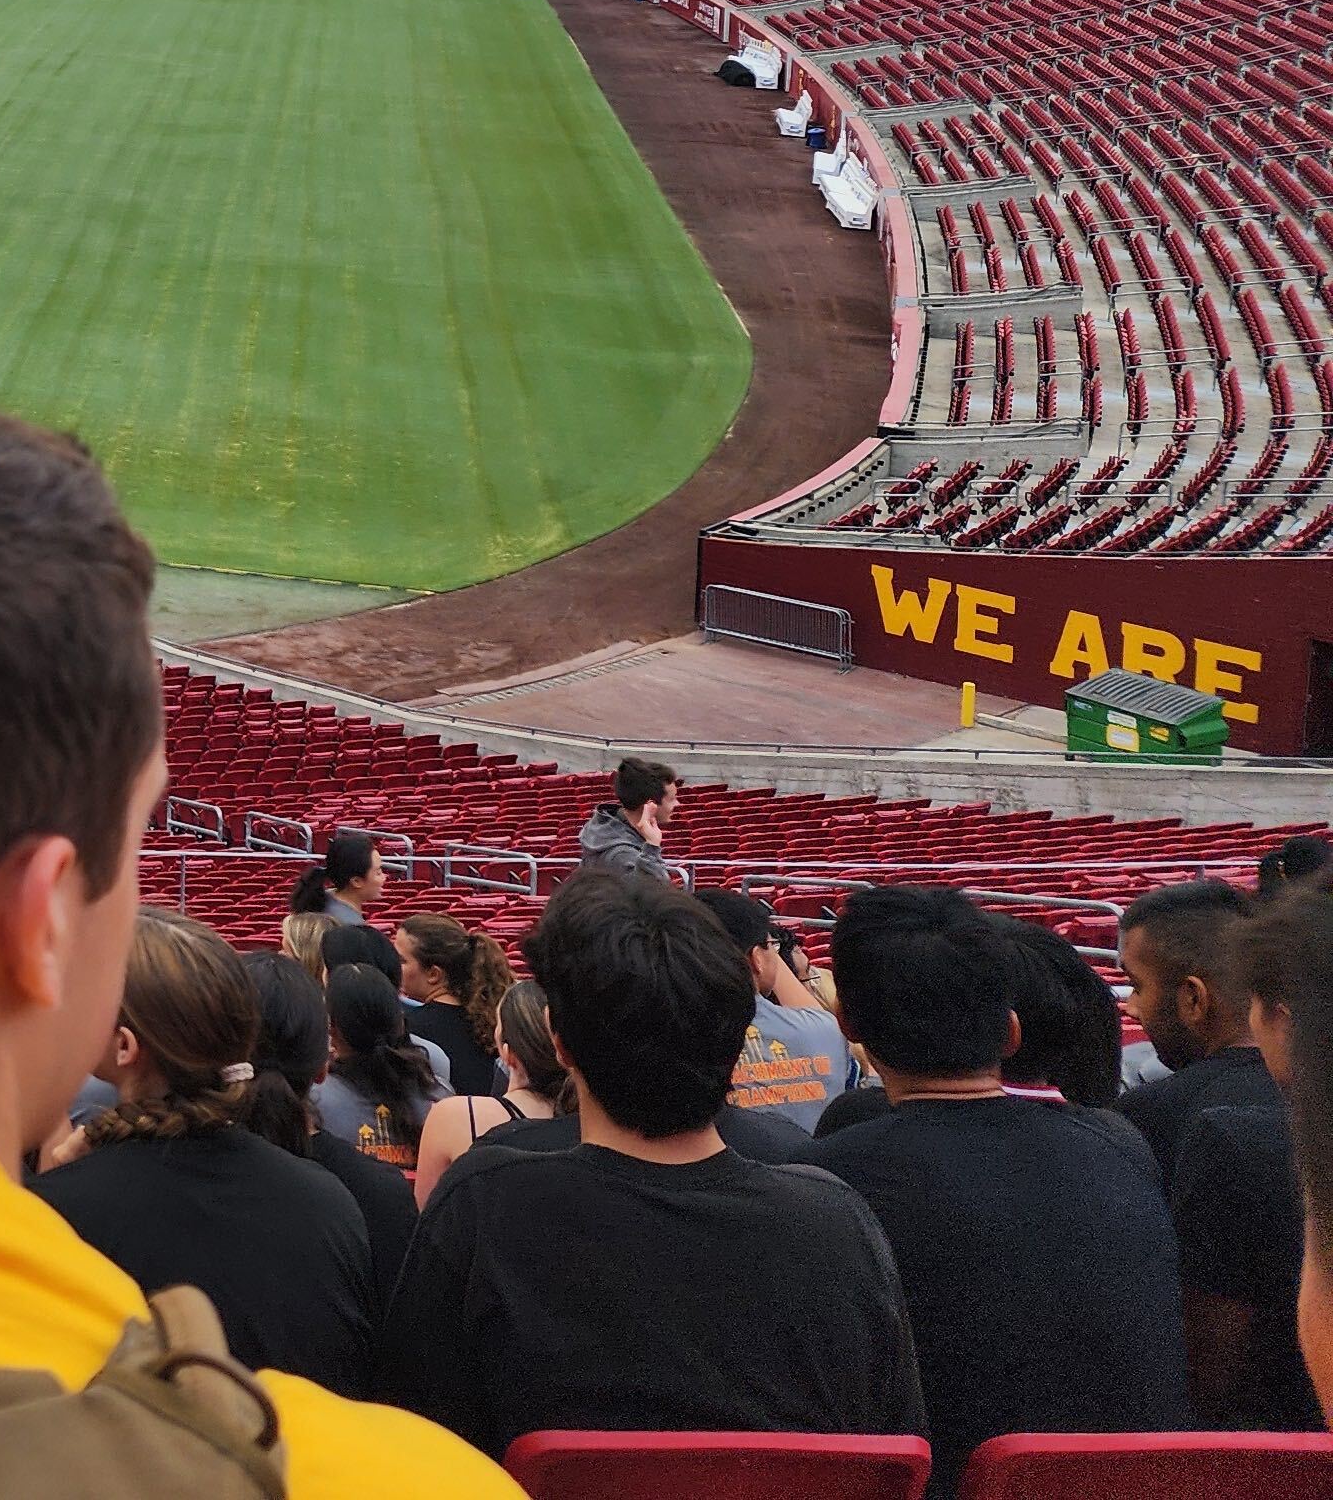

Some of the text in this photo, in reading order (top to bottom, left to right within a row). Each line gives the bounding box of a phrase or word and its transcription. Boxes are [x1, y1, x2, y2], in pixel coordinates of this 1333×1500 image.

[871, 564, 1263, 724] WE ARE
[730, 1057, 812, 1084] ACHMENT
